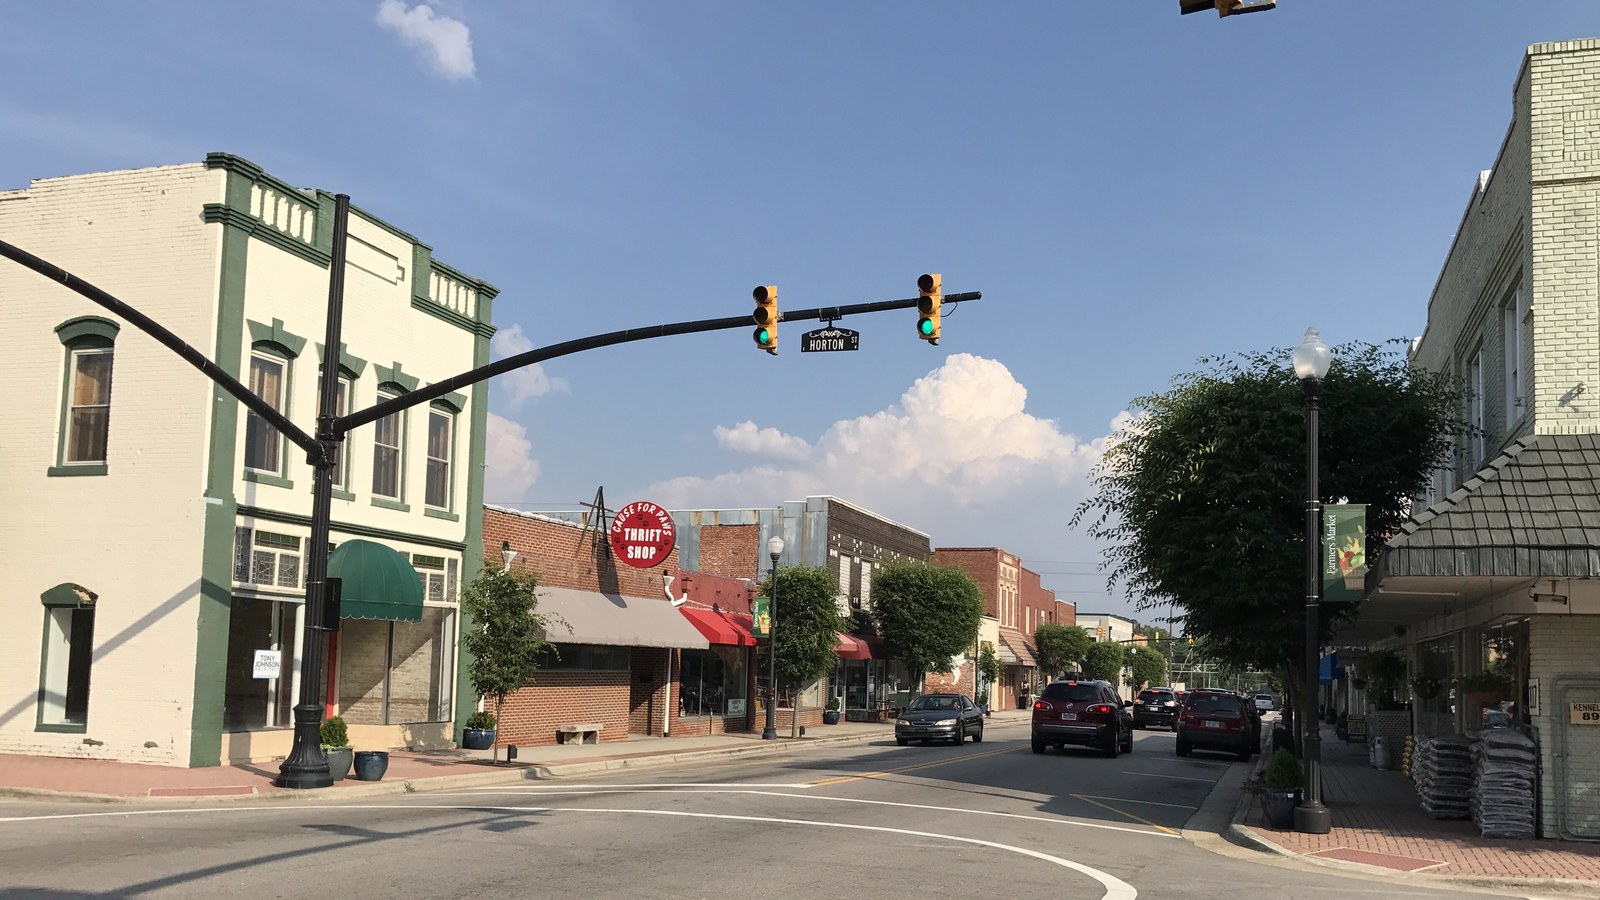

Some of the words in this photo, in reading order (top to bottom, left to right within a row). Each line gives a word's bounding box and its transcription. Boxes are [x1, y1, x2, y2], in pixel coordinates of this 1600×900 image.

[810, 339, 844, 350] HORTON
[612, 505, 635, 533] CAUSE
[637, 503, 656, 514] FOR
[655, 510, 672, 536] PAWS
[1326, 514, 1336, 541] Market
[624, 528, 662, 542] THRIFT
[627, 545, 656, 559] SHOP
[1326, 542, 1336, 575] Farmers
